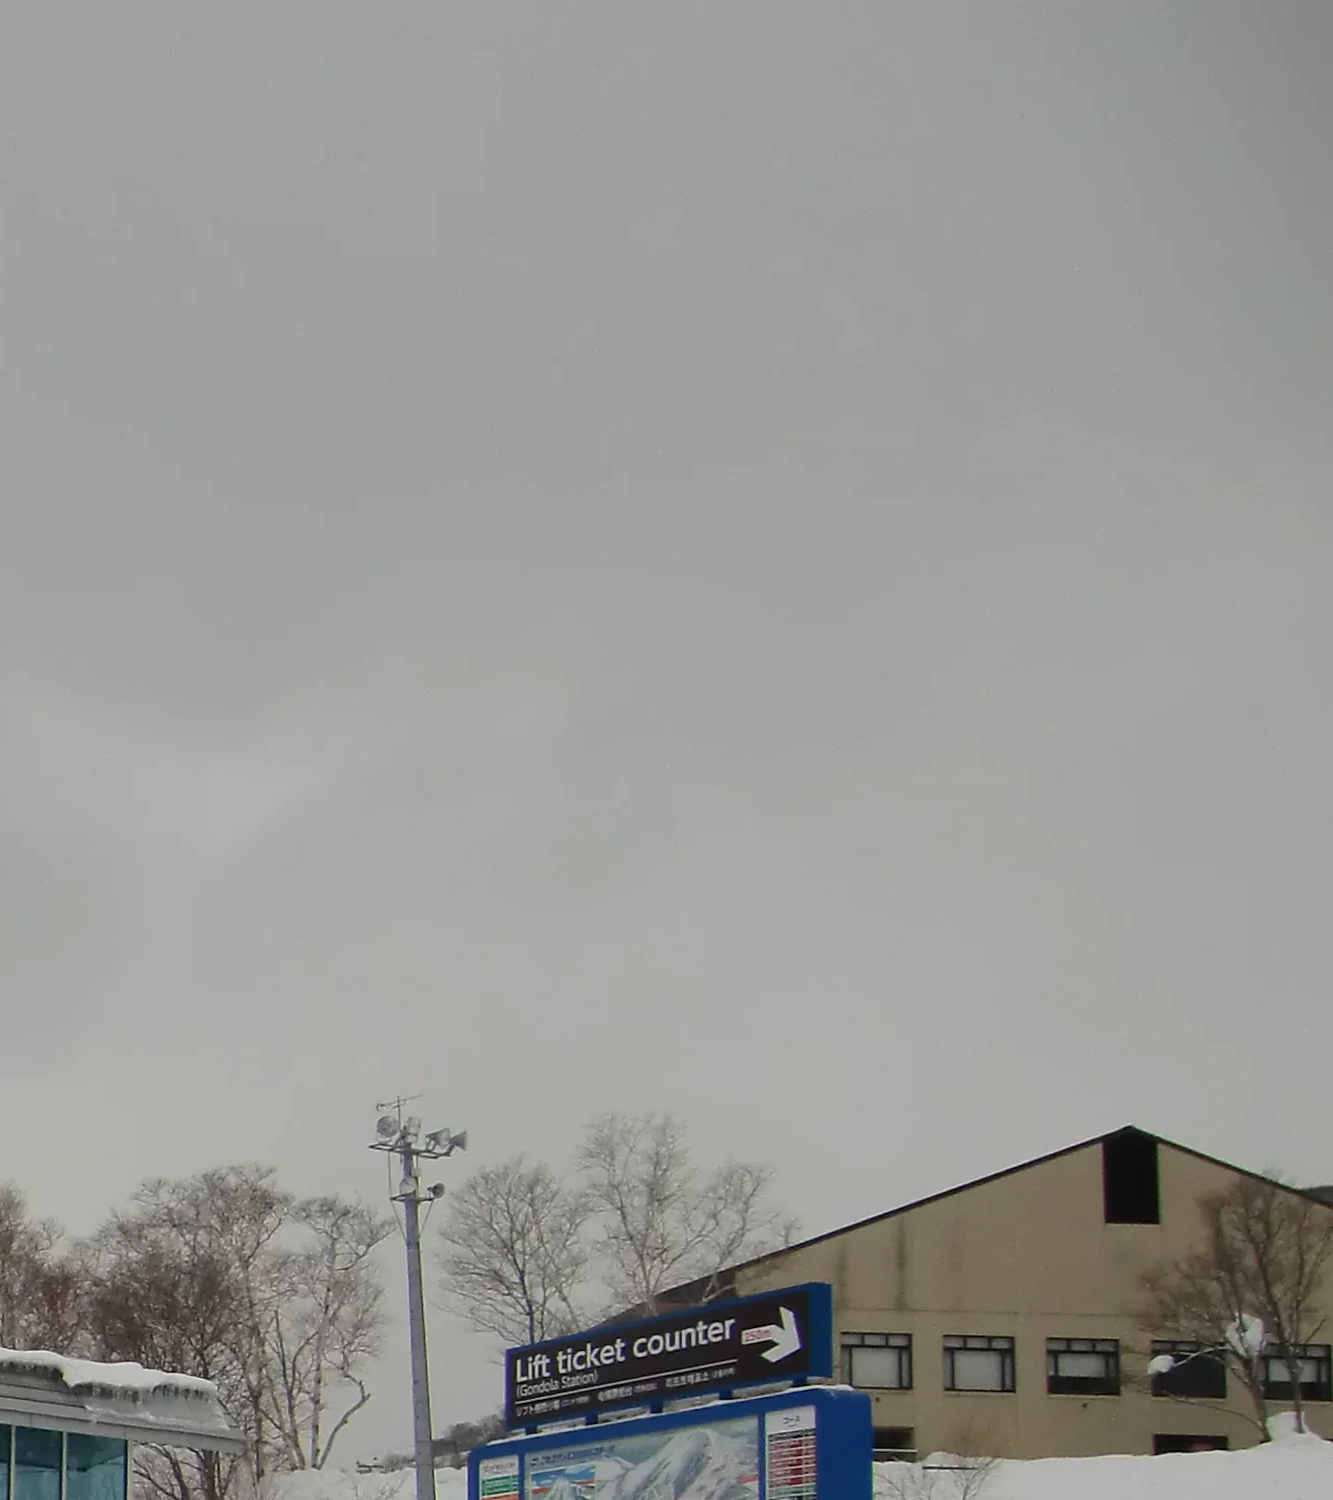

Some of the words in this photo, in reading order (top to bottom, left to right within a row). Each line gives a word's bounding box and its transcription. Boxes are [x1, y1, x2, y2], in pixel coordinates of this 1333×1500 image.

[516, 1353, 551, 1383] Lift
[556, 1338, 626, 1373] ticket
[633, 1318, 736, 1358] counter
[516, 1378, 560, 1398] (Gondola
[561, 1369, 598, 1389] Station)
